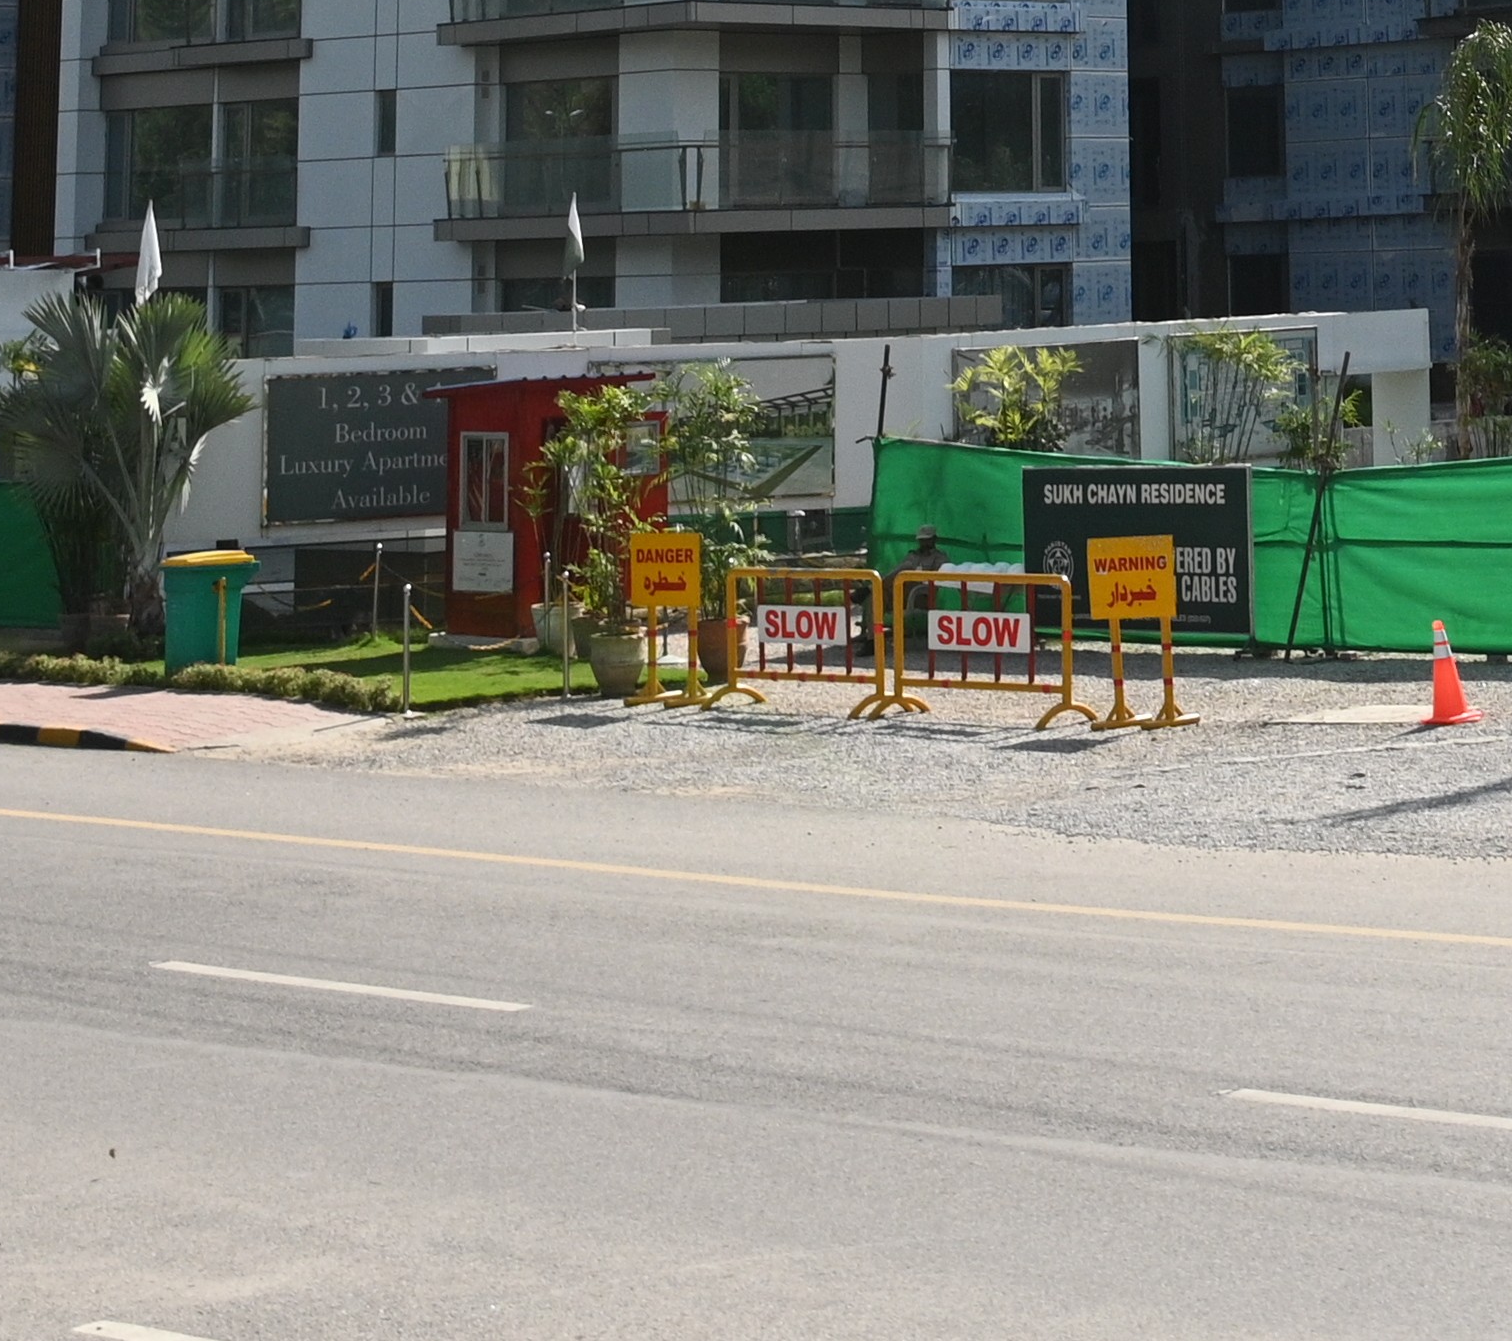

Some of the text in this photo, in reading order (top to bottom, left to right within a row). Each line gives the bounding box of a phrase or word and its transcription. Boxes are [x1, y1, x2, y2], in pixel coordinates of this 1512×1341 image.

[377, 385, 392, 407] 3
[400, 382, 421, 406] &
[335, 422, 427, 444] Bedroom
[279, 450, 448, 478] Luxury Apartme
[332, 485, 430, 509] Available
[1044, 483, 1226, 505] SUKH CHAYN RESIDENCE
[636, 548, 694, 564] DANGER
[1094, 555, 1168, 574] WARNING
[1175, 547, 1236, 575] ERED BY
[1106, 578, 1158, 608] خبردار
[1181, 575, 1238, 604] CABLES
[764, 609, 838, 641] SLOW
[937, 615, 1021, 648] SLOW
